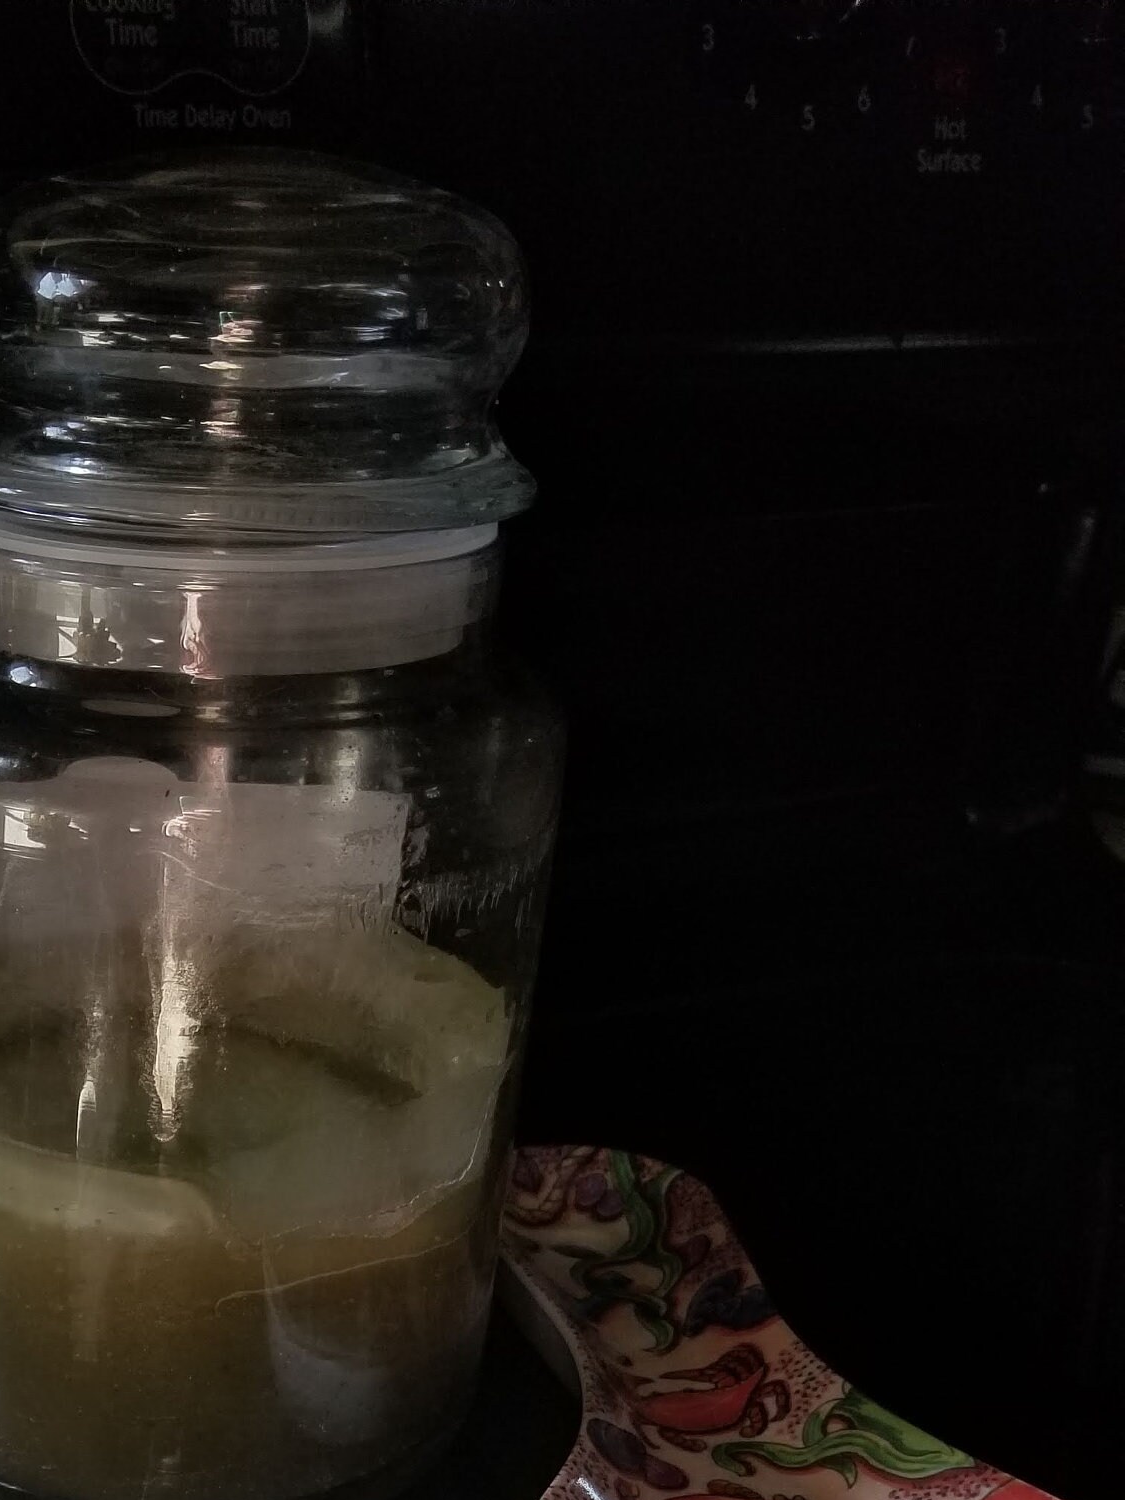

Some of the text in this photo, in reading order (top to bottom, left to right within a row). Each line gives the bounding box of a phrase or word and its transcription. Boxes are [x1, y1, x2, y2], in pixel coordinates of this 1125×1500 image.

[104, 16, 159, 47] Time
[228, 20, 281, 48] Time
[133, 102, 292, 131] Time Delay Oven
[933, 115, 967, 141] Hot
[916, 148, 983, 174] Surface
